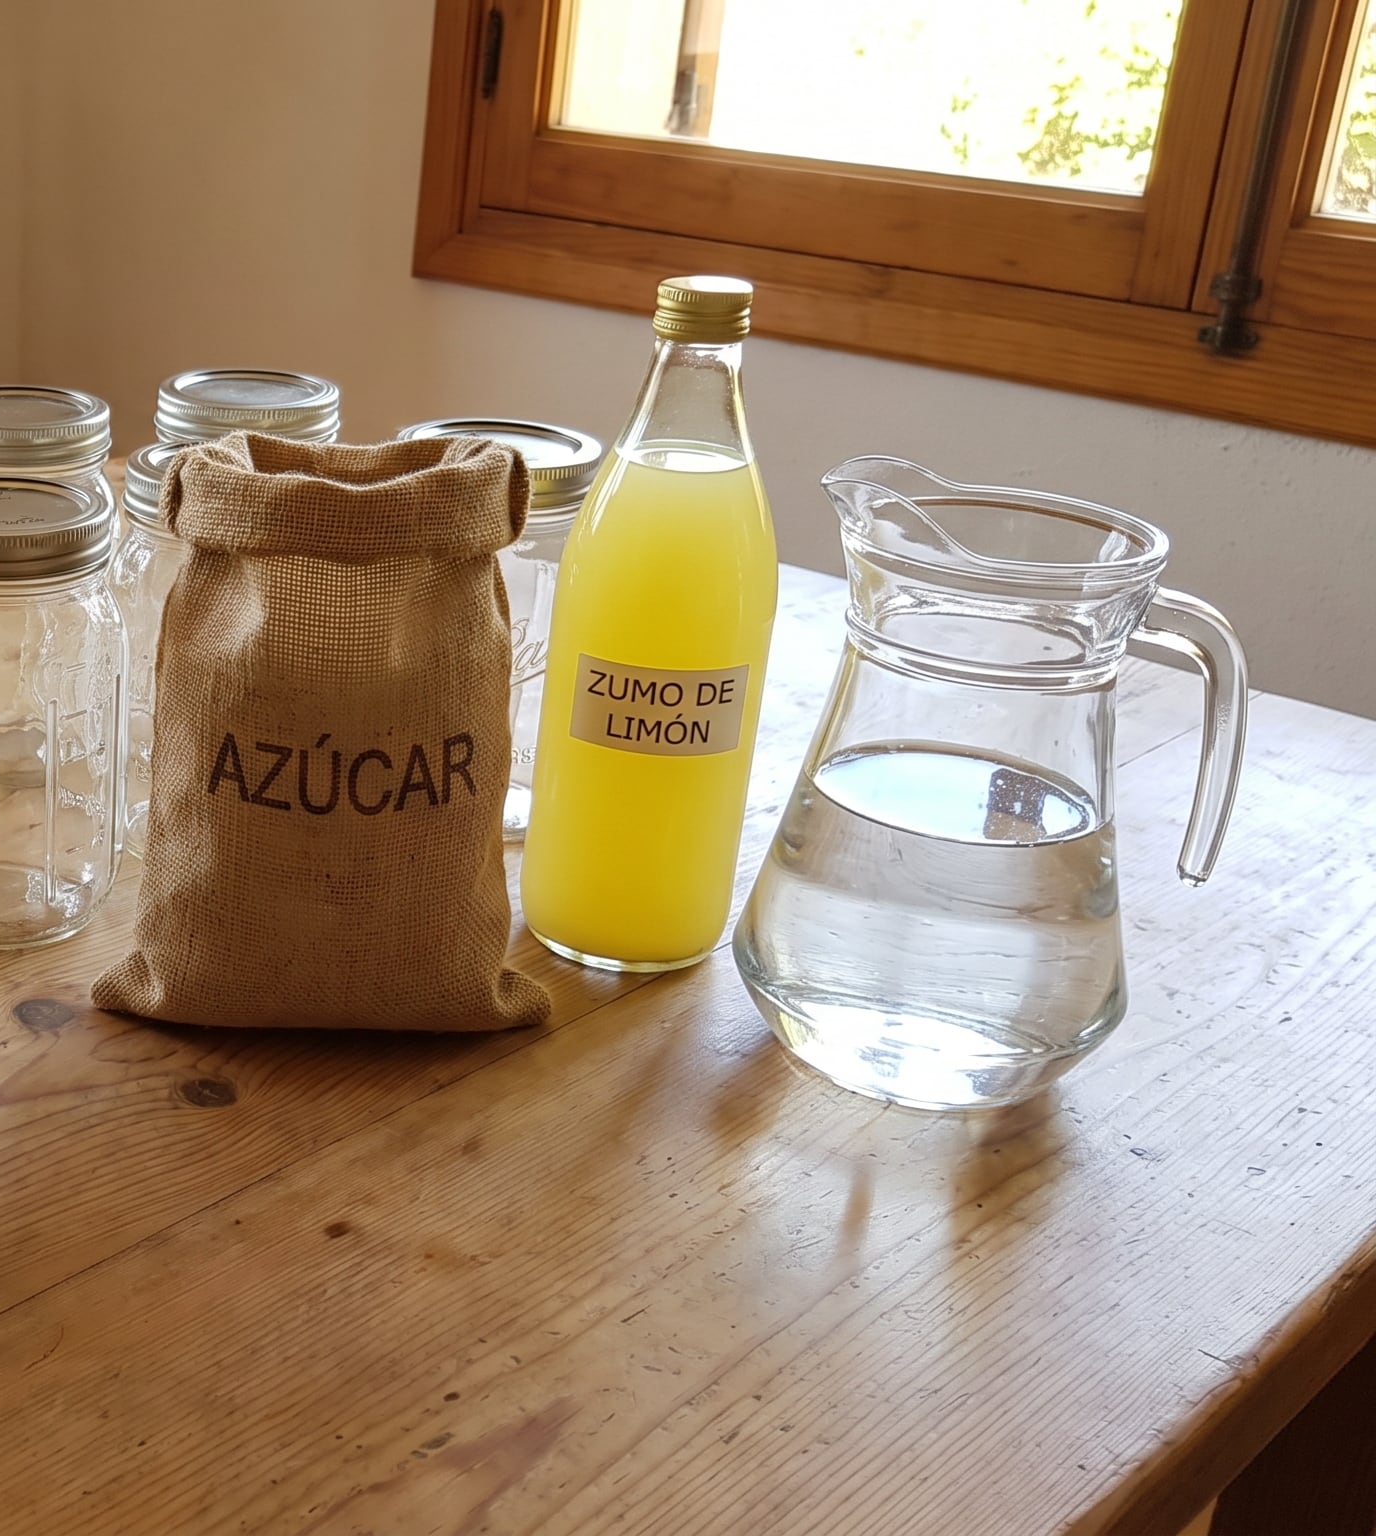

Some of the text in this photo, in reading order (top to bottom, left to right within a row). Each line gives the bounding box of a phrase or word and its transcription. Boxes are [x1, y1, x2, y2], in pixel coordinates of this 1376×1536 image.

[587, 669, 735, 707] ZUMO DE
[606, 713, 710, 745] LIMÓN
[207, 731, 477, 816] AZÚCAR
